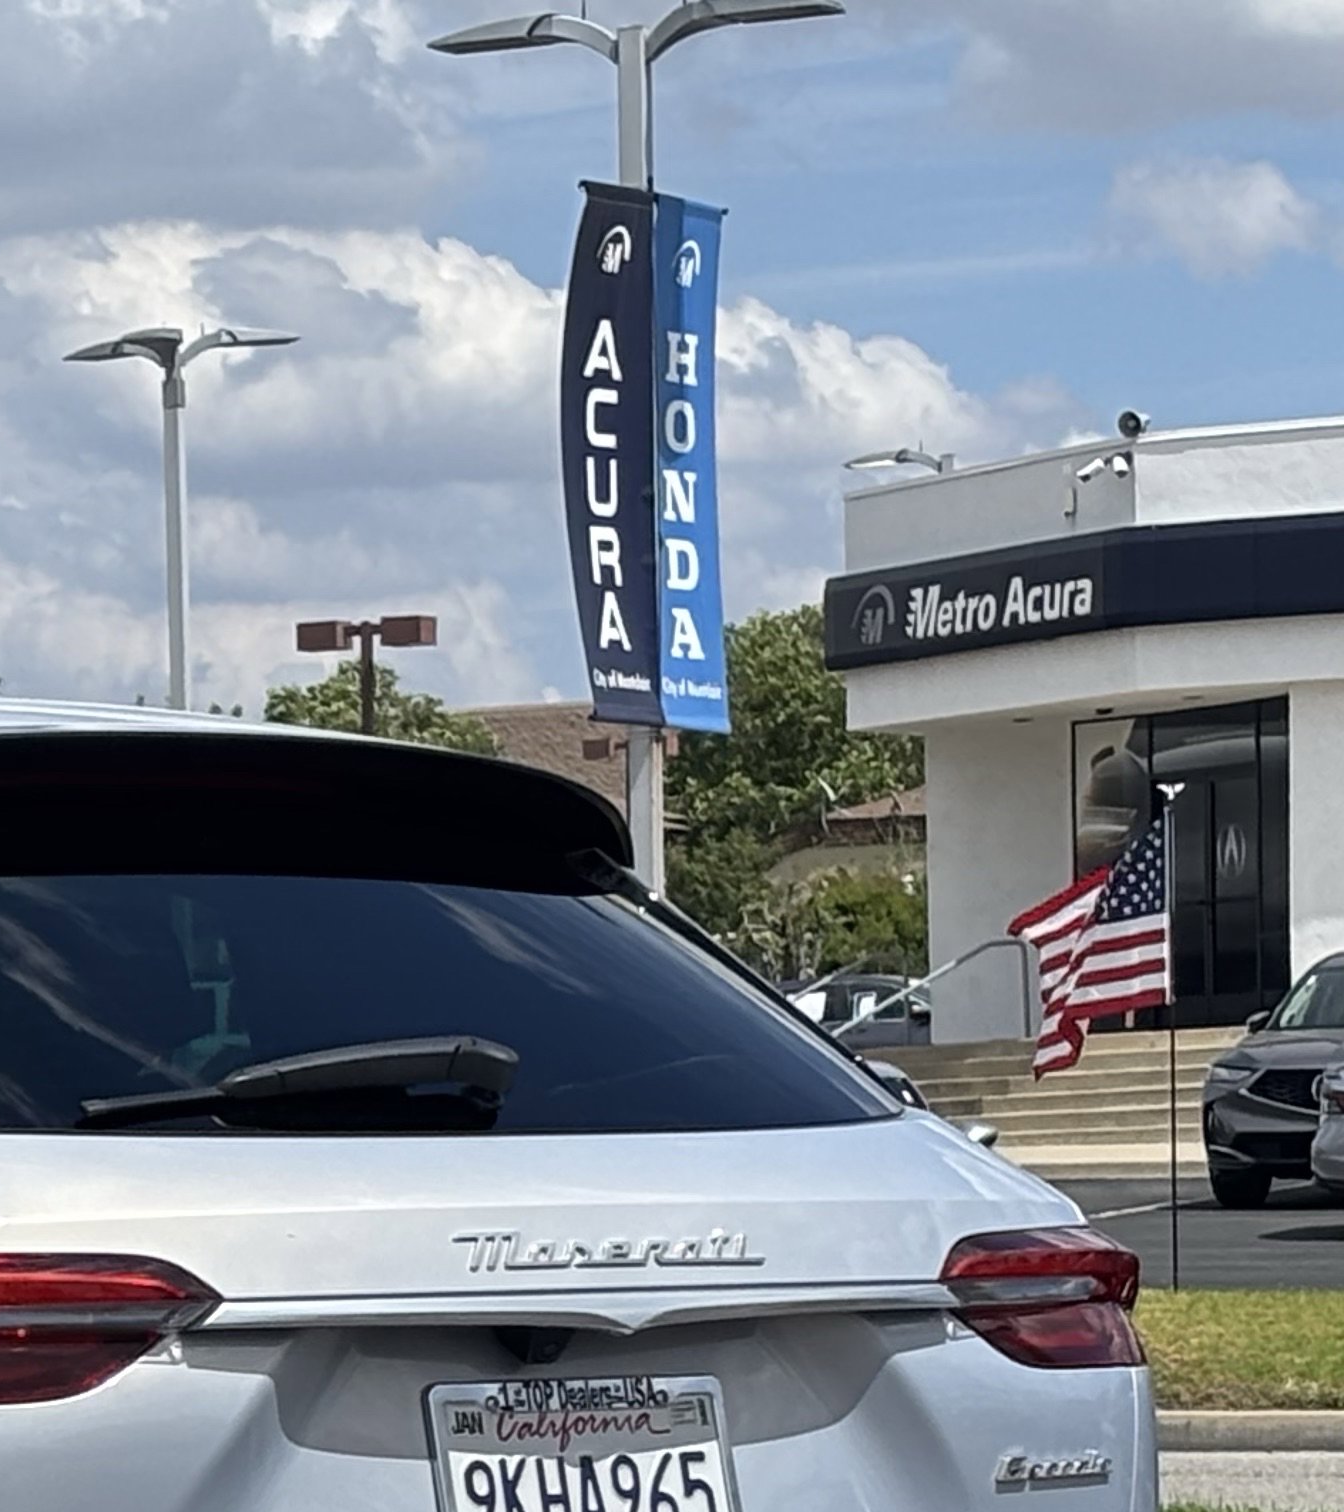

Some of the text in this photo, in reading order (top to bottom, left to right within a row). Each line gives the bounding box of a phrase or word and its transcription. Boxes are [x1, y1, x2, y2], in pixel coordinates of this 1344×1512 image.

[583, 318, 632, 653] ACURA
[662, 330, 707, 661] HONDA
[905, 576, 1093, 641] Metro Acura
[451, 1230, 766, 1273] Maserati
[452, 1411, 672, 1453] JAN California
